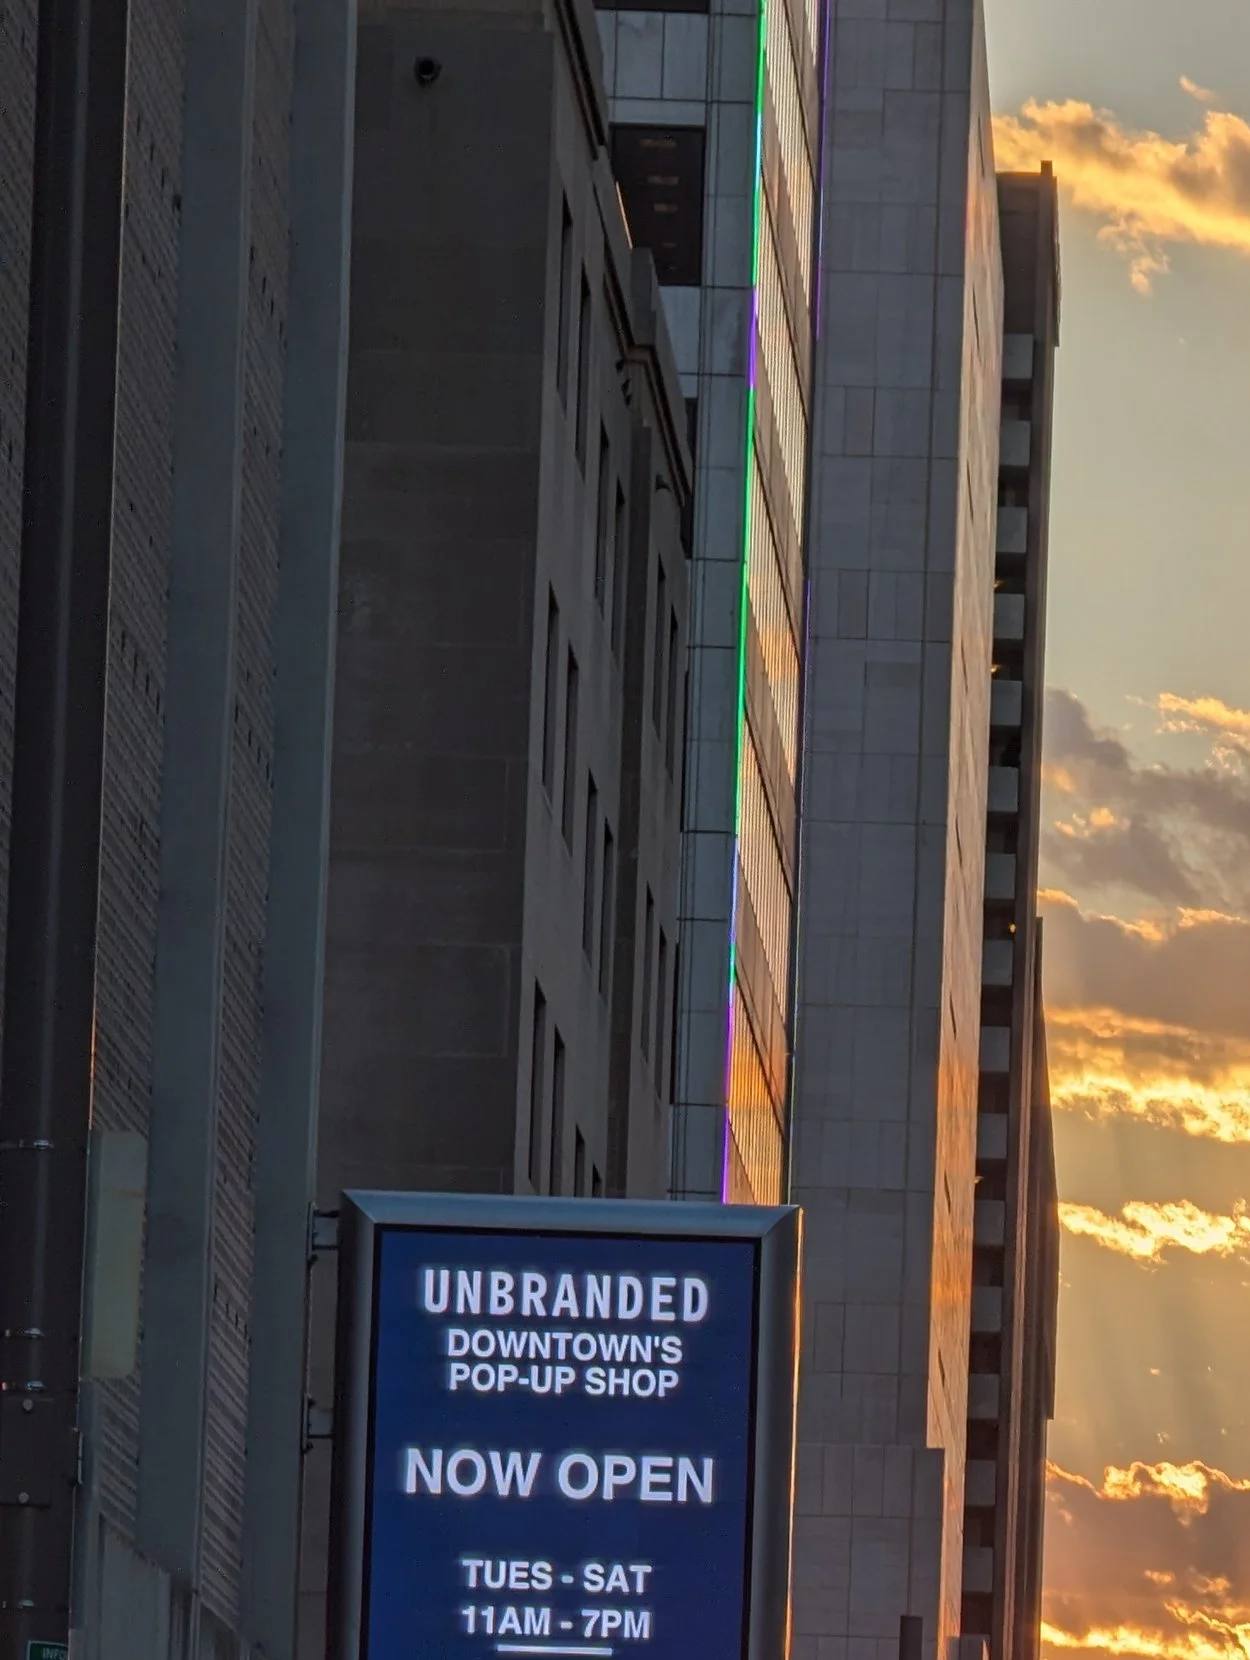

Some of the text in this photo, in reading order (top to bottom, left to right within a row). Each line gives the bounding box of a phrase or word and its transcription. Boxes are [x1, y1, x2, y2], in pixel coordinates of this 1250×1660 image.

[423, 1269, 709, 1322] UNBRANDED
[447, 1329, 684, 1364] DOWNTOWN'S
[449, 1363, 680, 1397] POP-UP SHOP
[405, 1448, 714, 1503] NOW OPEN
[461, 1559, 554, 1590] TUES
[583, 1564, 652, 1594] SAT
[462, 1606, 551, 1636] 11AM
[581, 1609, 651, 1639] 7PM
